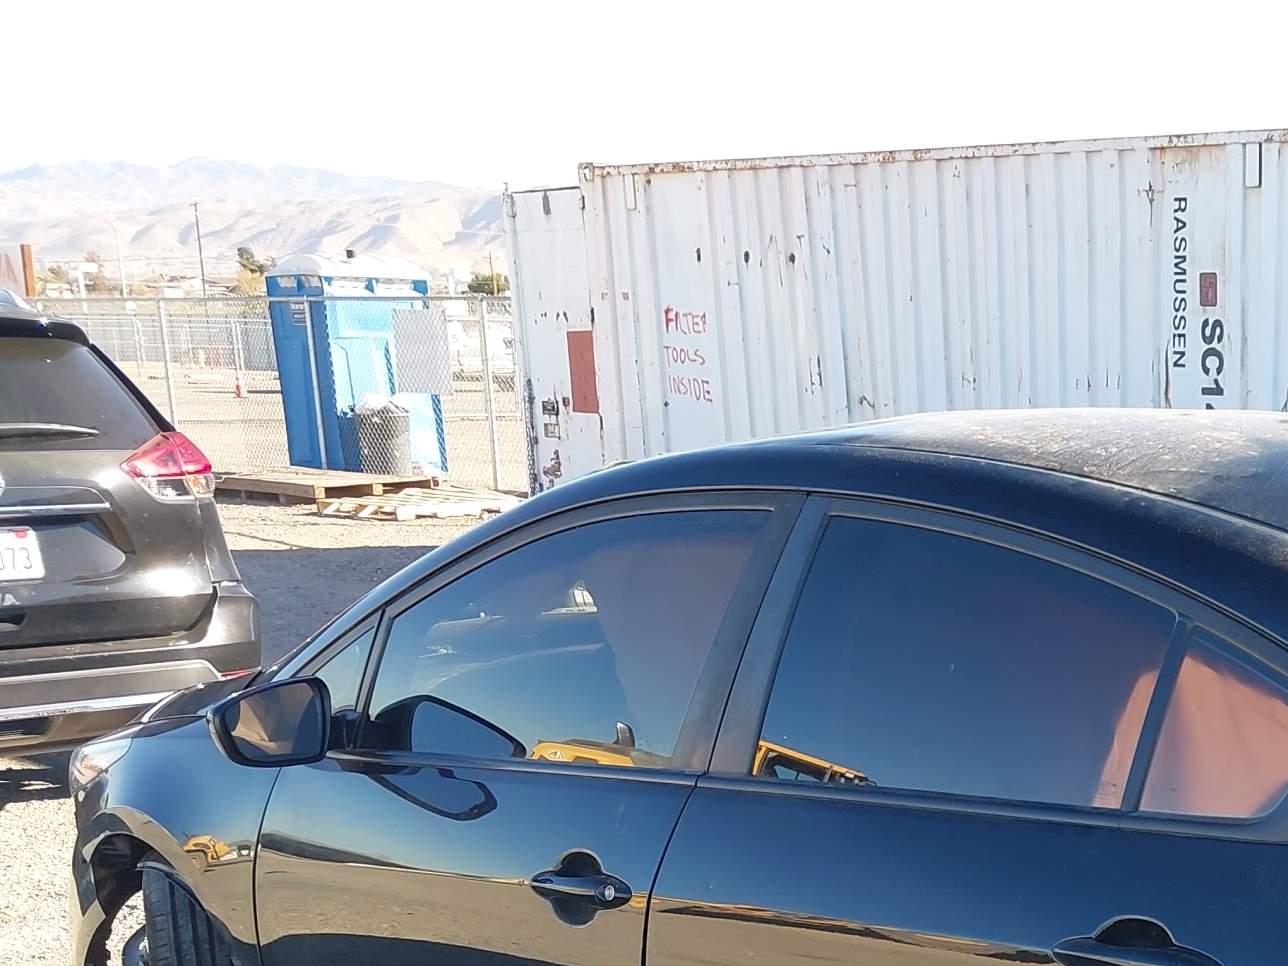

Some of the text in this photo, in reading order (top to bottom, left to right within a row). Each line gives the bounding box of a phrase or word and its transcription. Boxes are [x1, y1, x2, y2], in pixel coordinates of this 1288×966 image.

[1172, 197, 1188, 369] RASMUSSEN
[663, 345, 706, 368] TOOLS
[1200, 317, 1225, 410] SC1
[668, 374, 713, 403] INSIDE
